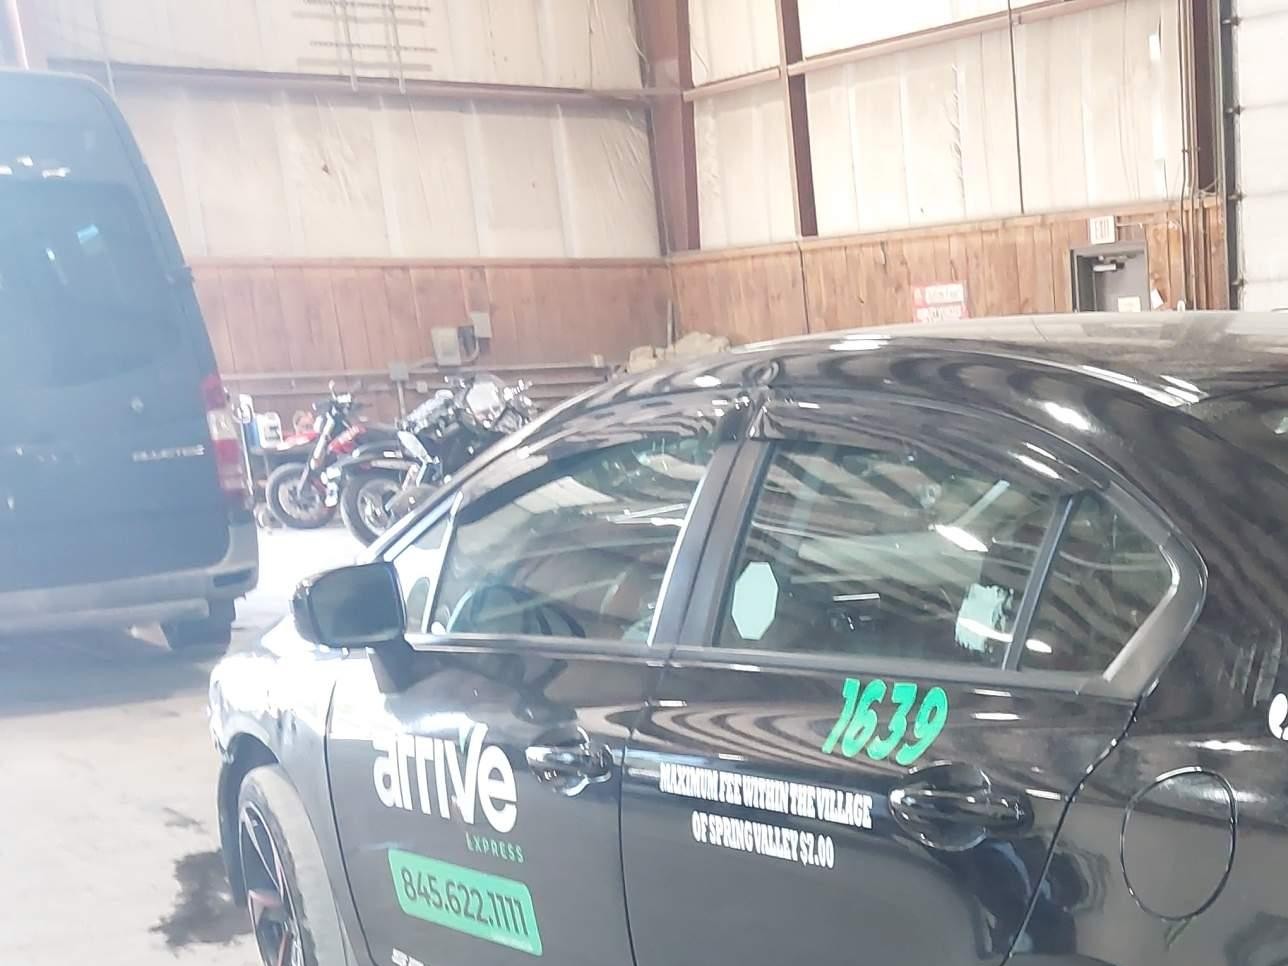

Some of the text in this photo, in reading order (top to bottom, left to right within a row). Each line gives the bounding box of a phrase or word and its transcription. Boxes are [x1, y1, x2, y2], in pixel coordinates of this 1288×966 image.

[821, 678, 948, 766] 1639
[372, 722, 518, 833] arrive
[659, 762, 873, 829] MAXIMUM FEE WITHIN THE VILLAGE
[465, 831, 524, 864] EXPRESS
[691, 810, 708, 843] OF
[708, 813, 754, 852] SPRING
[752, 821, 799, 862] VALLEY
[401, 867, 529, 937] 845.622.1111
